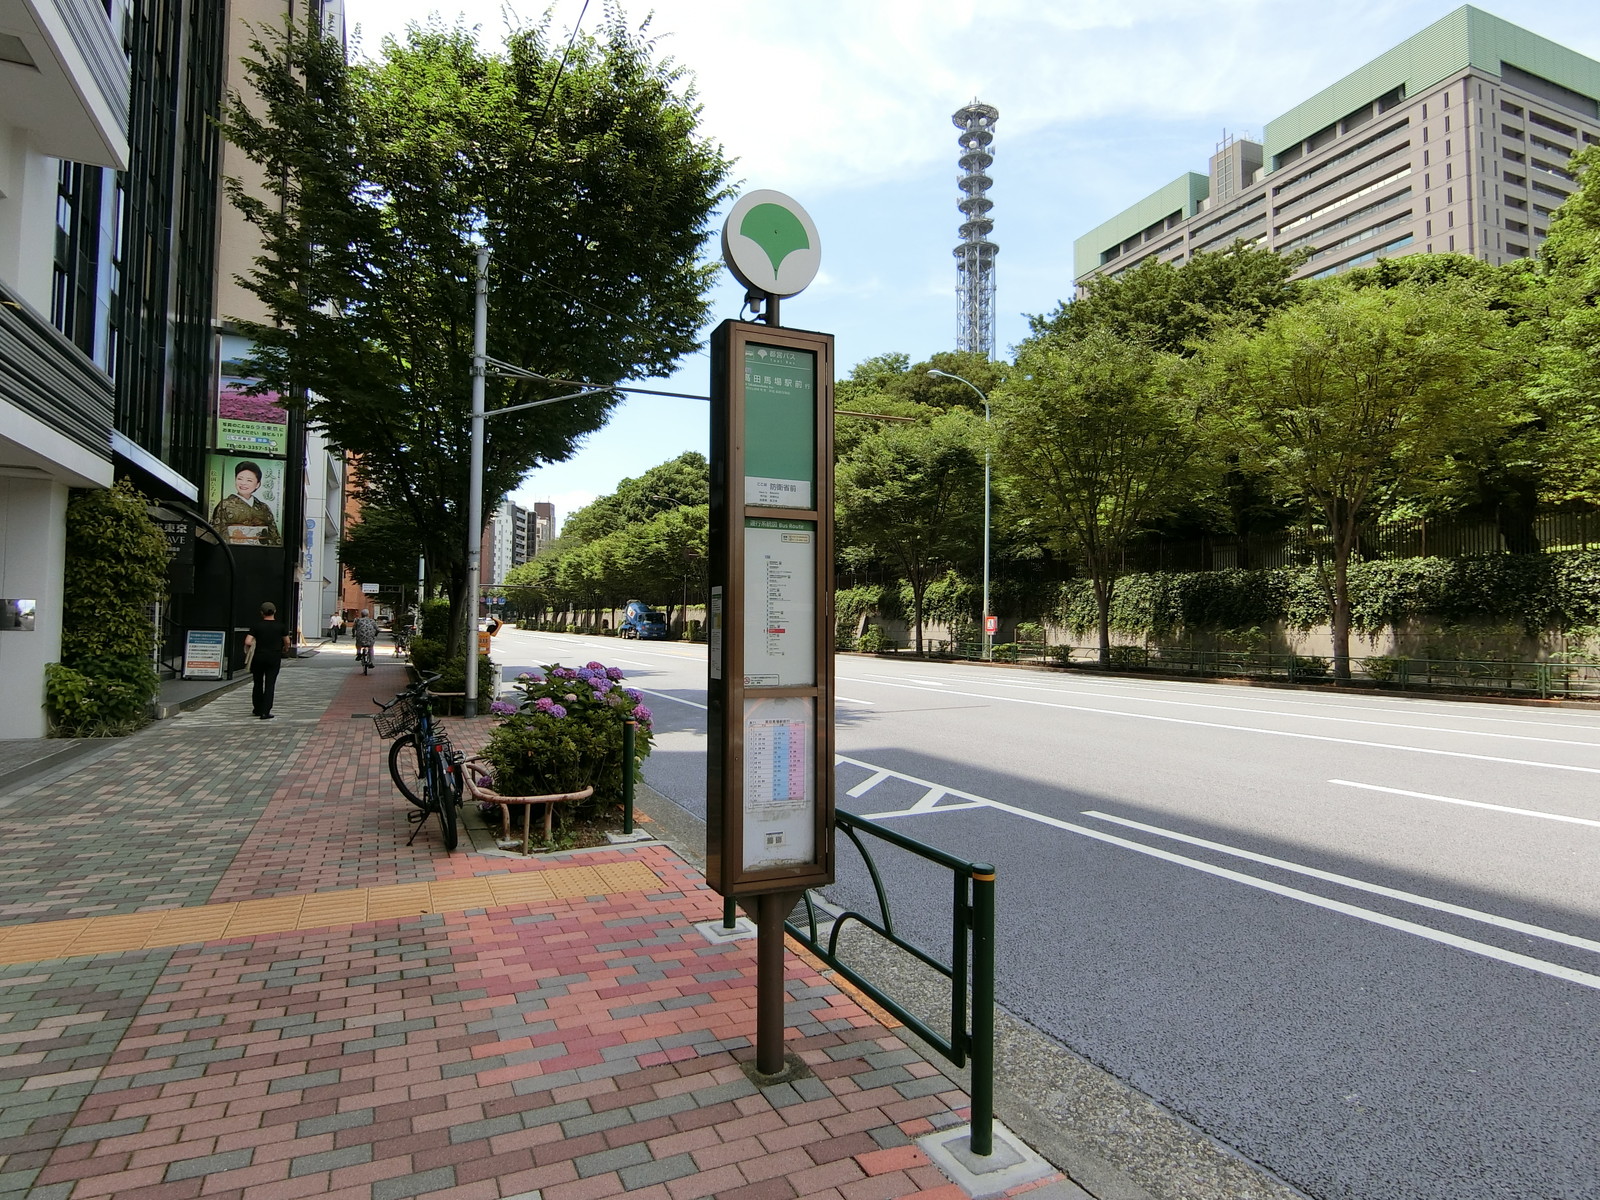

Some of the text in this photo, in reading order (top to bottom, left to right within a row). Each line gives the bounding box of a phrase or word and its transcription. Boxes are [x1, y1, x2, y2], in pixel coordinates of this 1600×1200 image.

[770, 350, 796, 360] 都営バス
[770, 482, 797, 493] 防衛省前
